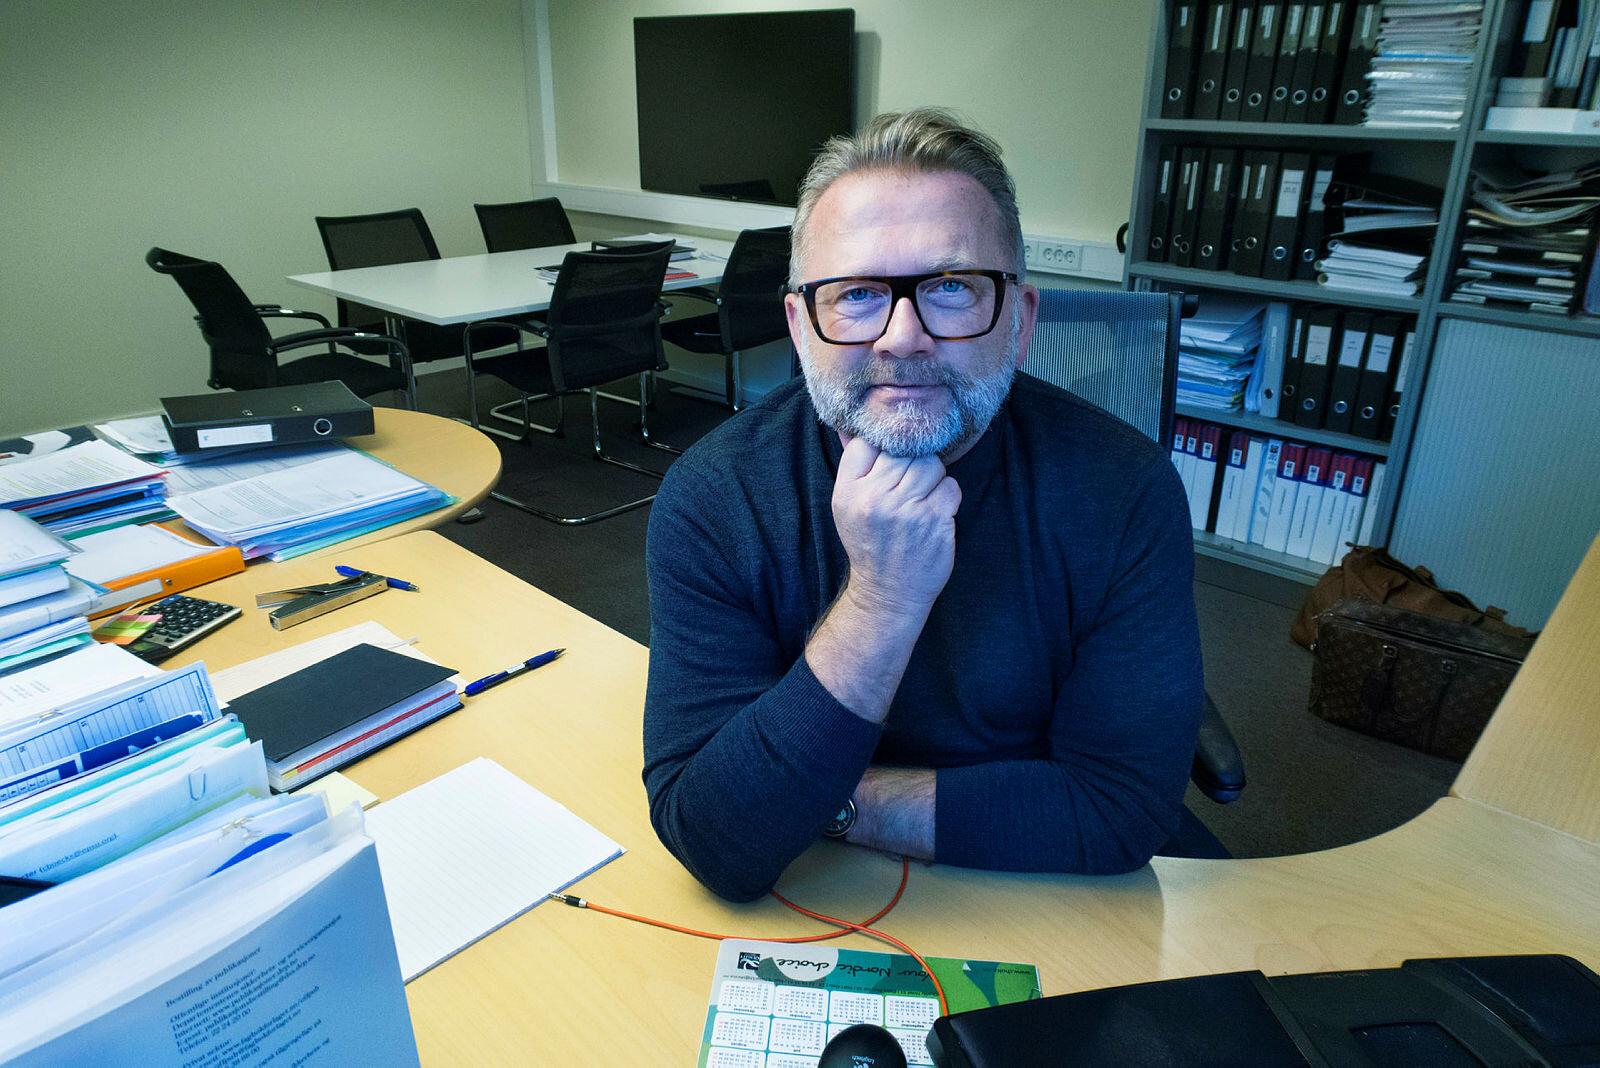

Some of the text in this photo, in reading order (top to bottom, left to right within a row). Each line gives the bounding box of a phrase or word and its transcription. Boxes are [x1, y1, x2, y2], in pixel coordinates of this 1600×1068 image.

[776, 957, 830, 974] choice
[836, 963, 892, 979] Nordic
[851, 1055, 875, 1064] Logitech
